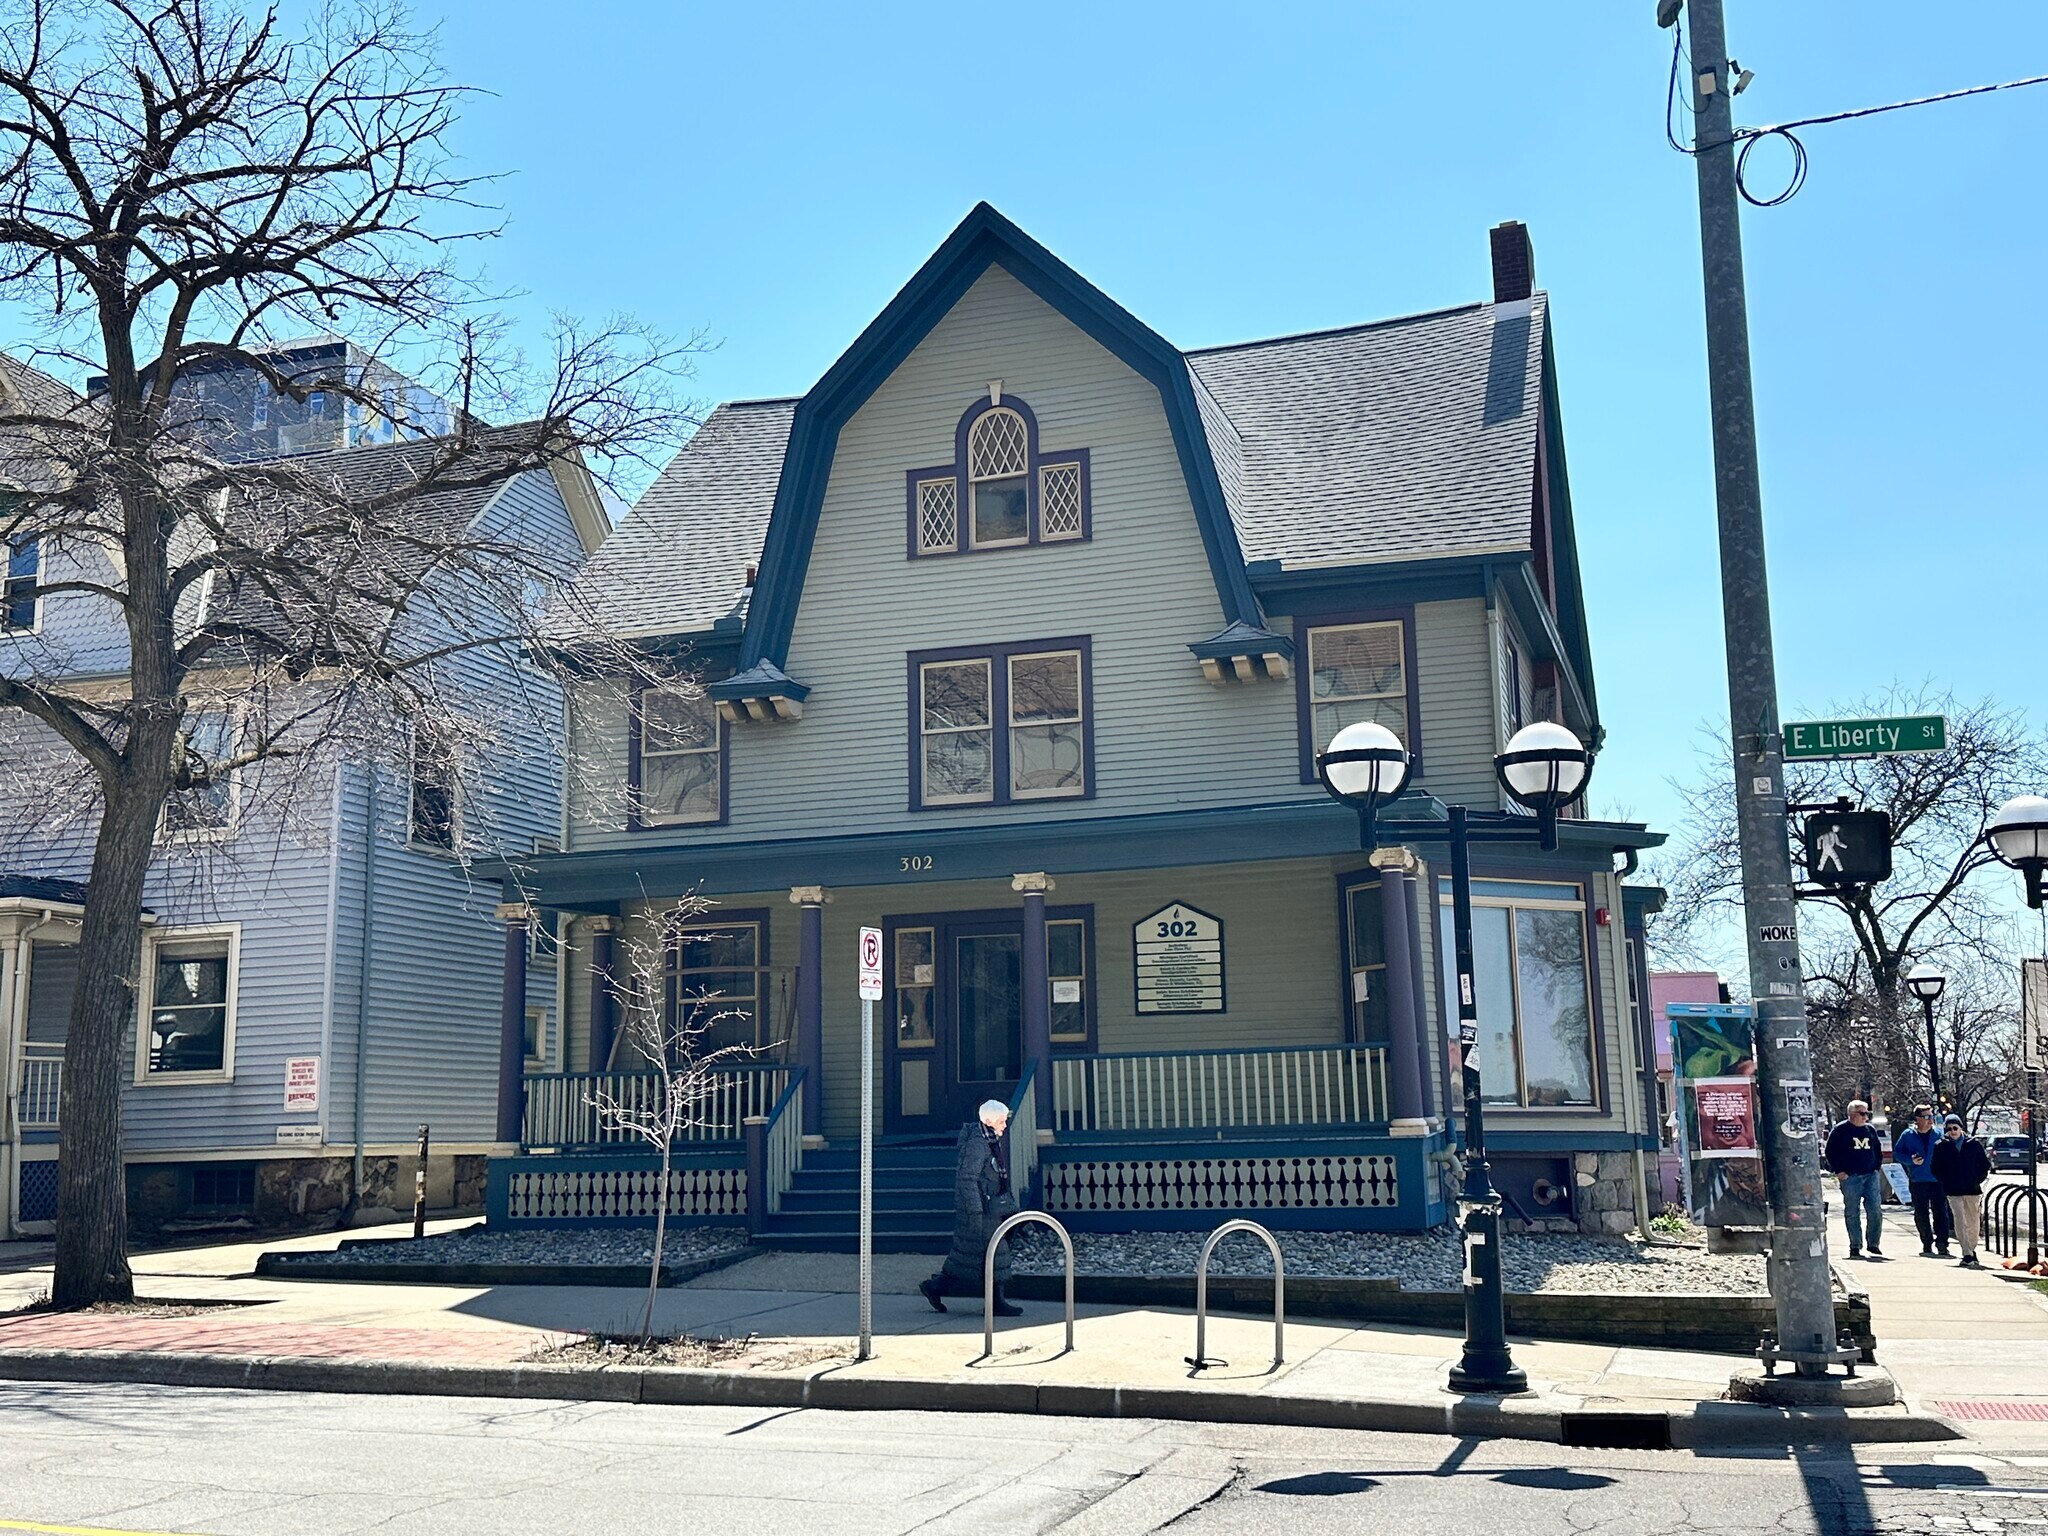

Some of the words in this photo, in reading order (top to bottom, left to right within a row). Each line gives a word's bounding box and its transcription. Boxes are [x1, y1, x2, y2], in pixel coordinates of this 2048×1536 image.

[1793, 727, 1812, 749] E.
[1819, 724, 1900, 750] Liberty
[1923, 726, 1935, 737] St
[900, 856, 932, 871] 302
[1157, 921, 1197, 937] 302
[1761, 927, 1795, 940] WOKE
[289, 1093, 315, 1102] BREWERS
[1853, 1137, 1870, 1149] M
